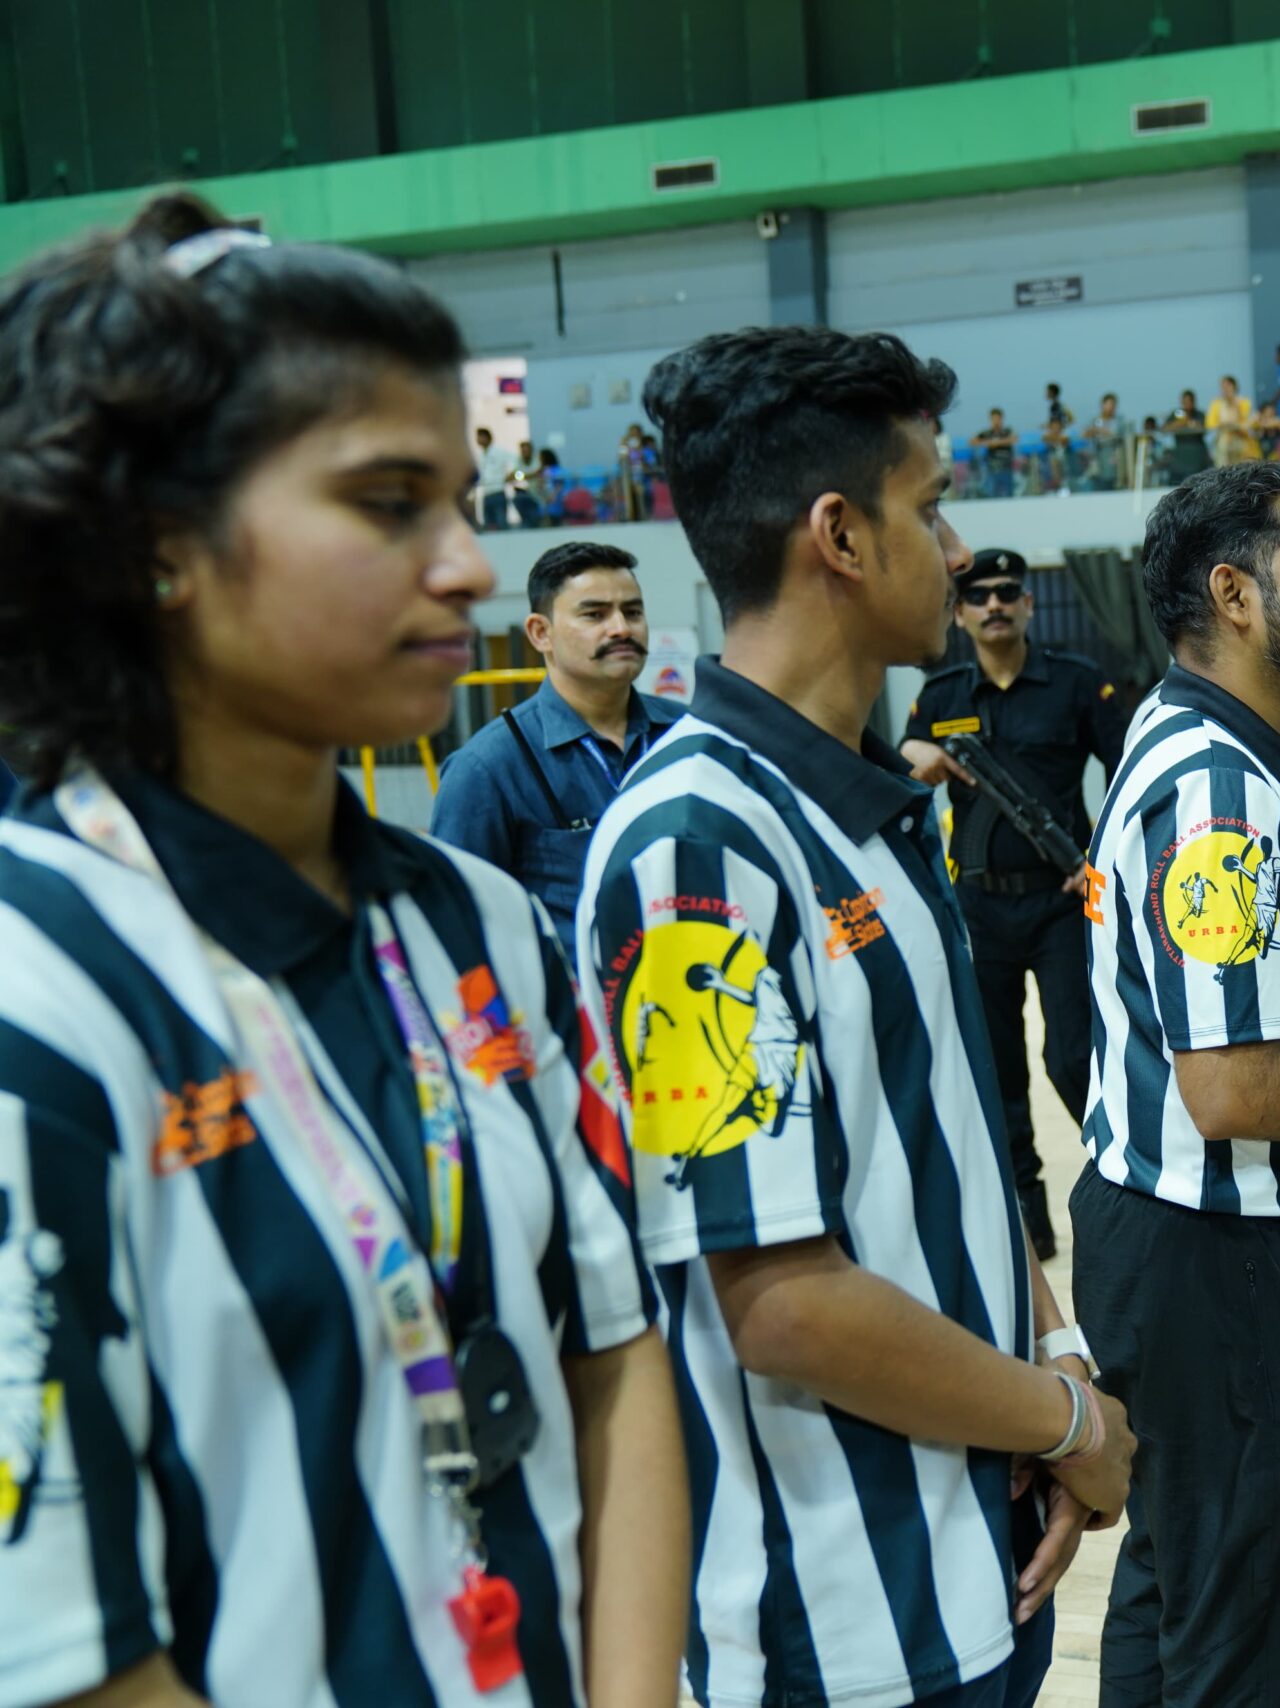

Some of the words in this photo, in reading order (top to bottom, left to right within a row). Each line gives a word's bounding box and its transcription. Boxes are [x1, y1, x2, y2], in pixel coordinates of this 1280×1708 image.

[1189, 817, 1260, 838] ASSOCIATION
[1162, 835, 1186, 859] BALL
[1150, 861, 1166, 889] ROLL
[1150, 892, 1185, 968] UTTARAKHAND
[1188, 925, 1239, 938] URBA
[633, 1085, 709, 1107] RBA
